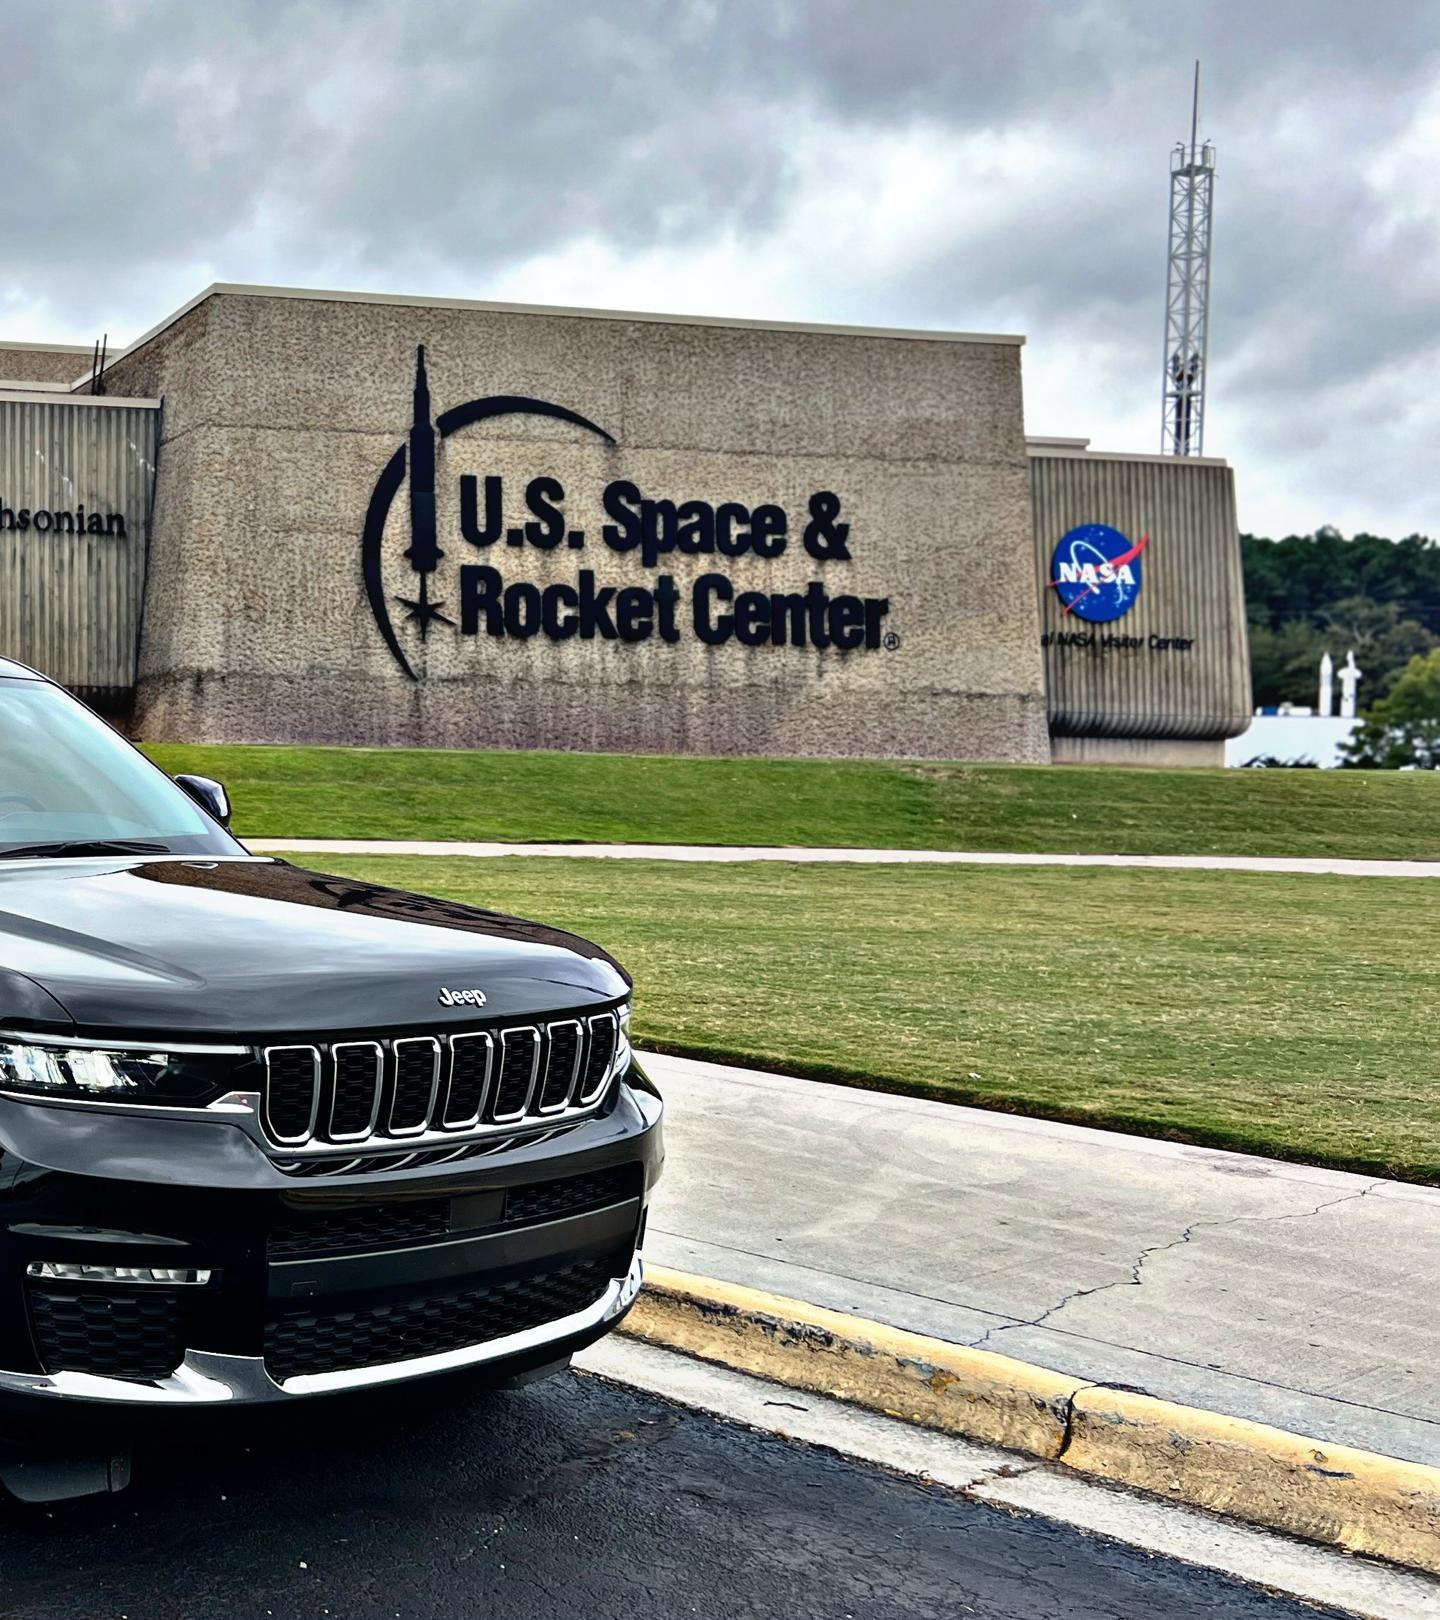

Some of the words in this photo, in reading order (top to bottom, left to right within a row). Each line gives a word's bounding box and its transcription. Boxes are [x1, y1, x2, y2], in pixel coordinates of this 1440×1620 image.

[460, 475, 585, 551] U.S.
[601, 479, 788, 568] Space
[803, 491, 853, 561] &
[1058, 562, 1136, 585] NASA
[460, 564, 680, 643] Rocket
[1058, 631, 1096, 647] NASA
[1100, 632, 1144, 649] Visitor
[1148, 633, 1195, 651] Center
[439, 986, 487, 1008] Jeep
